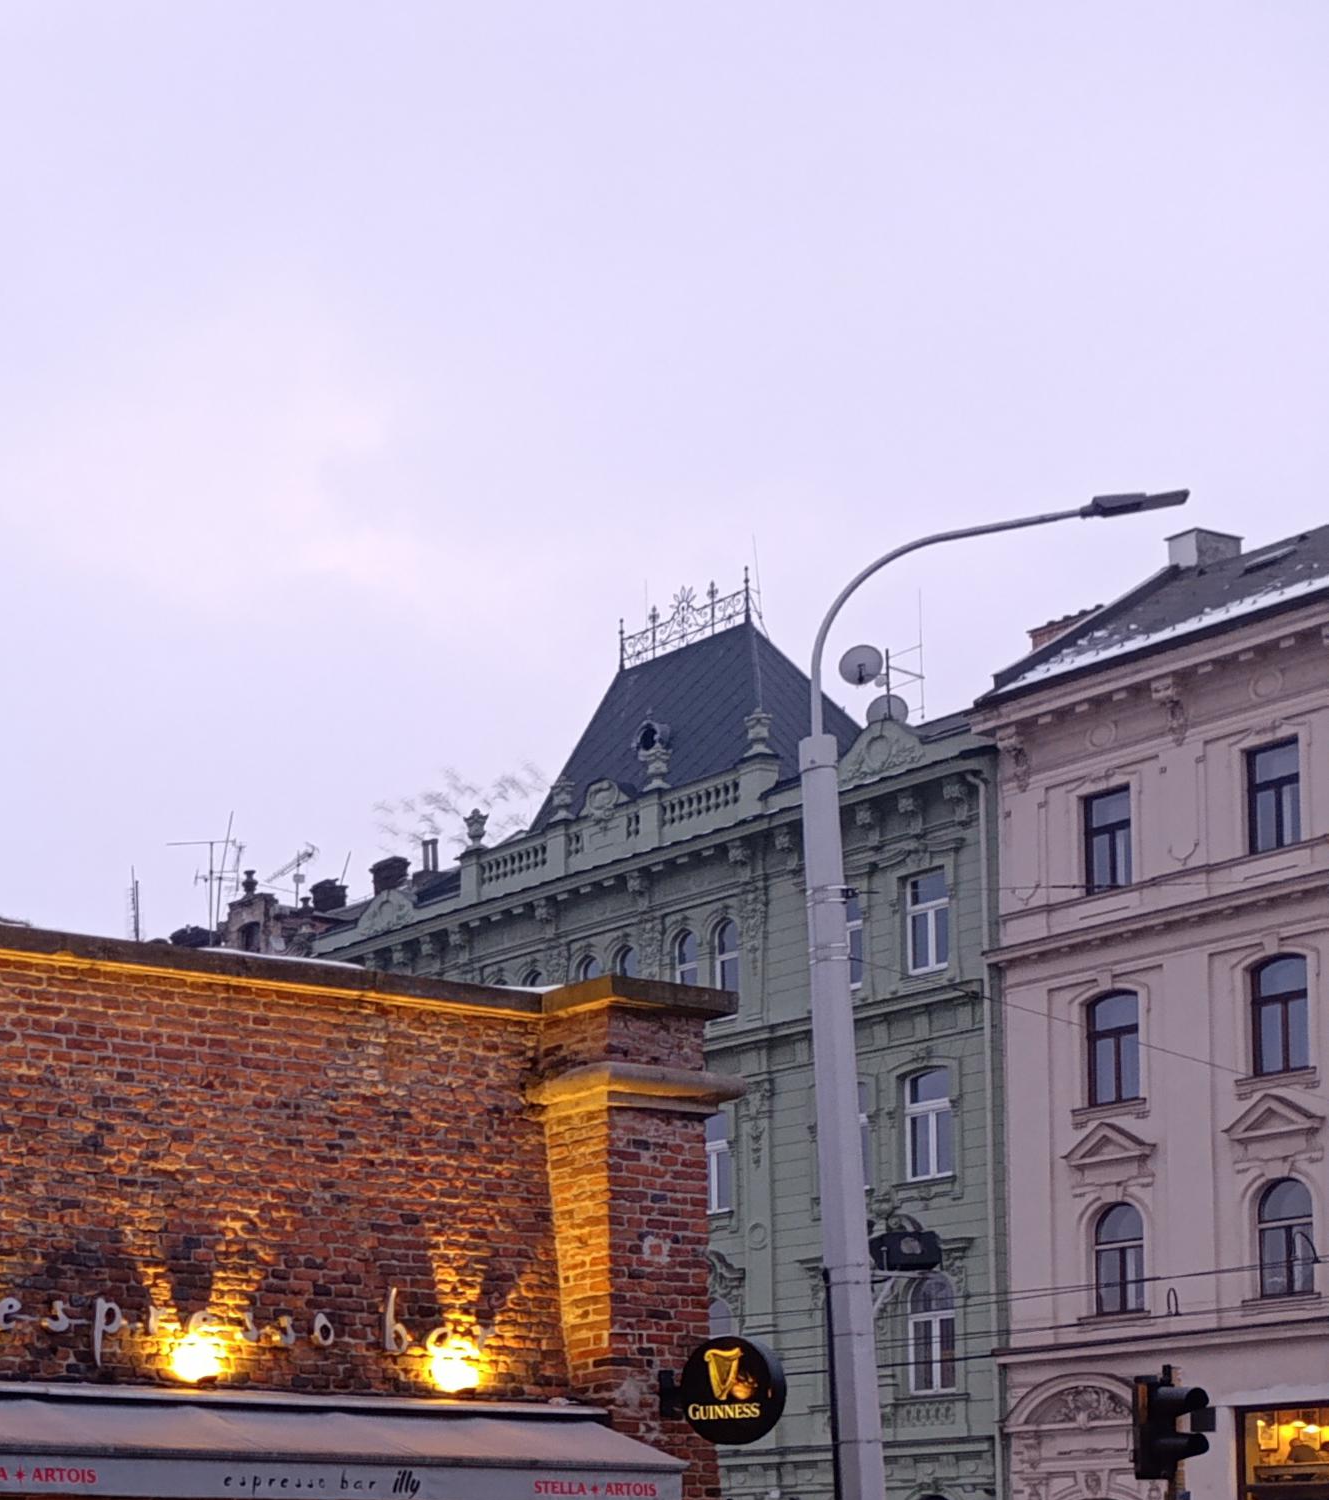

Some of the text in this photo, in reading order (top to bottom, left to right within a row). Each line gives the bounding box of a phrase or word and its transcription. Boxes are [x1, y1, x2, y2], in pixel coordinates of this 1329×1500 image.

[688, 1402, 761, 1420] GUINNESS
[32, 1467, 97, 1484] ARTOIS
[223, 1469, 421, 1499] espresso bar illy
[534, 1480, 657, 1497] STELLA ARTOIS
